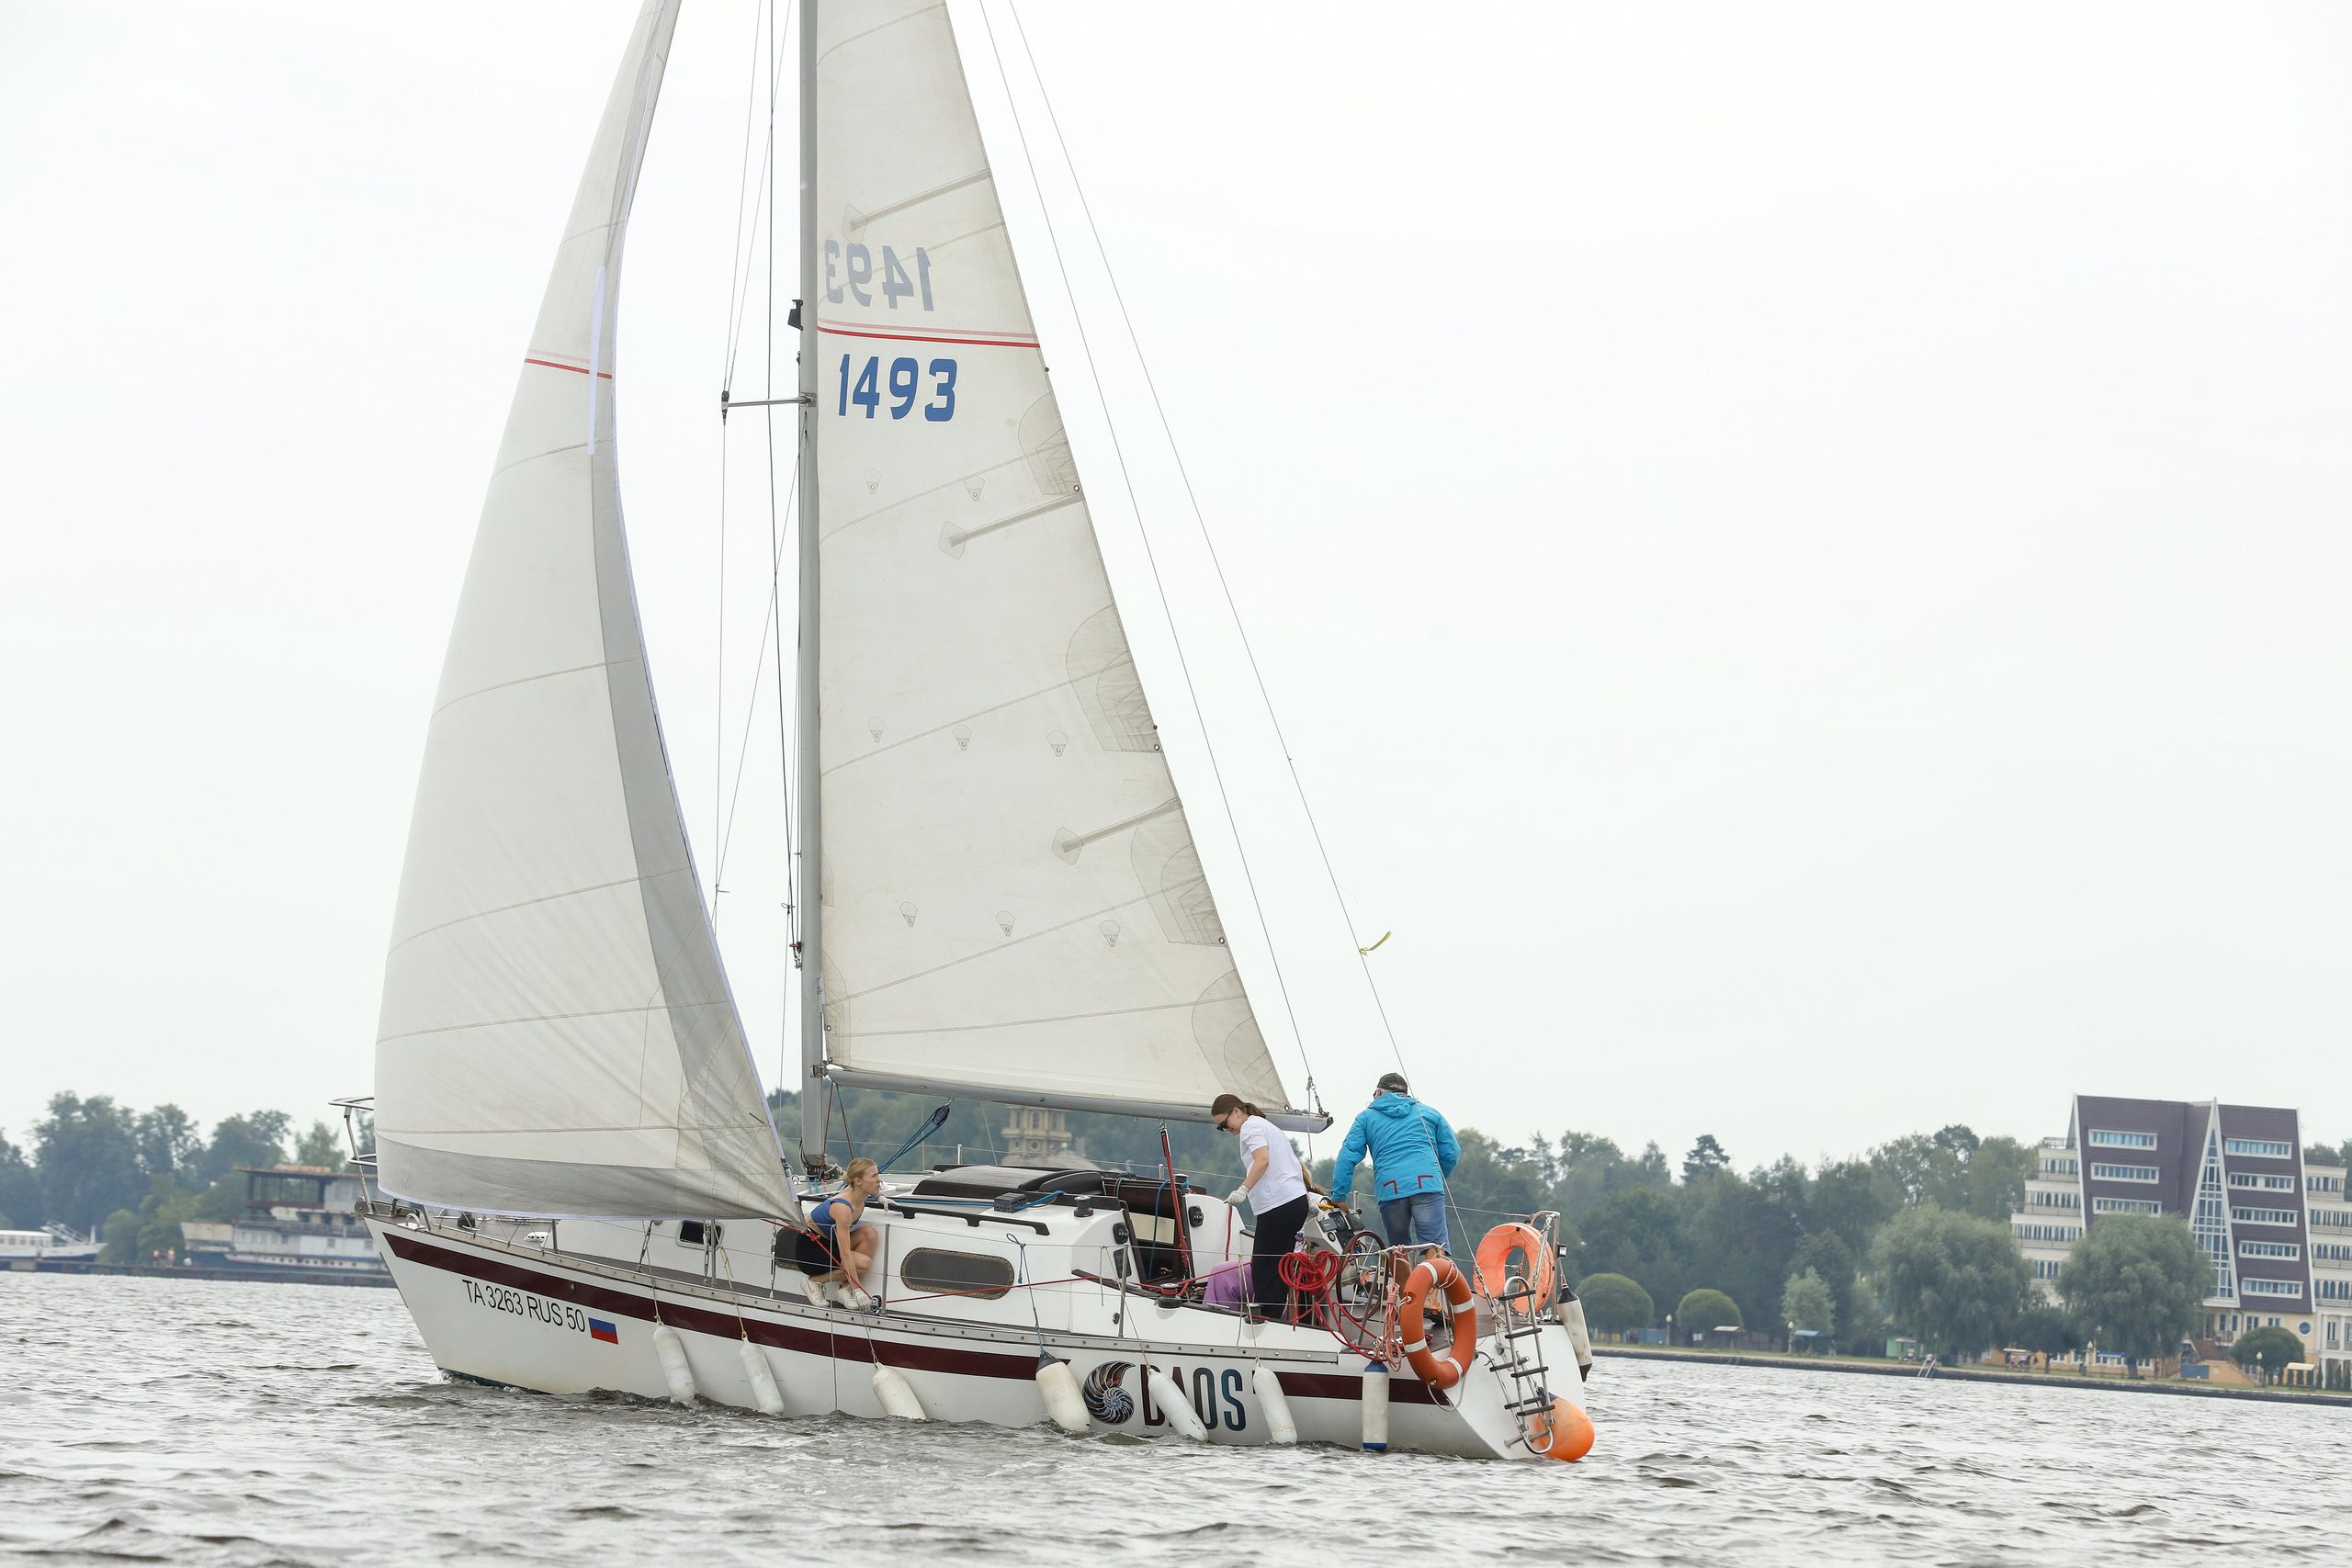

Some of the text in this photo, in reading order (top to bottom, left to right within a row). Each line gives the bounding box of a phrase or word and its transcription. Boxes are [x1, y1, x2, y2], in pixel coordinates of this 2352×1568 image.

[839, 354, 957, 422] 1493
[462, 1280, 585, 1332] TA 3263 RUS 50
